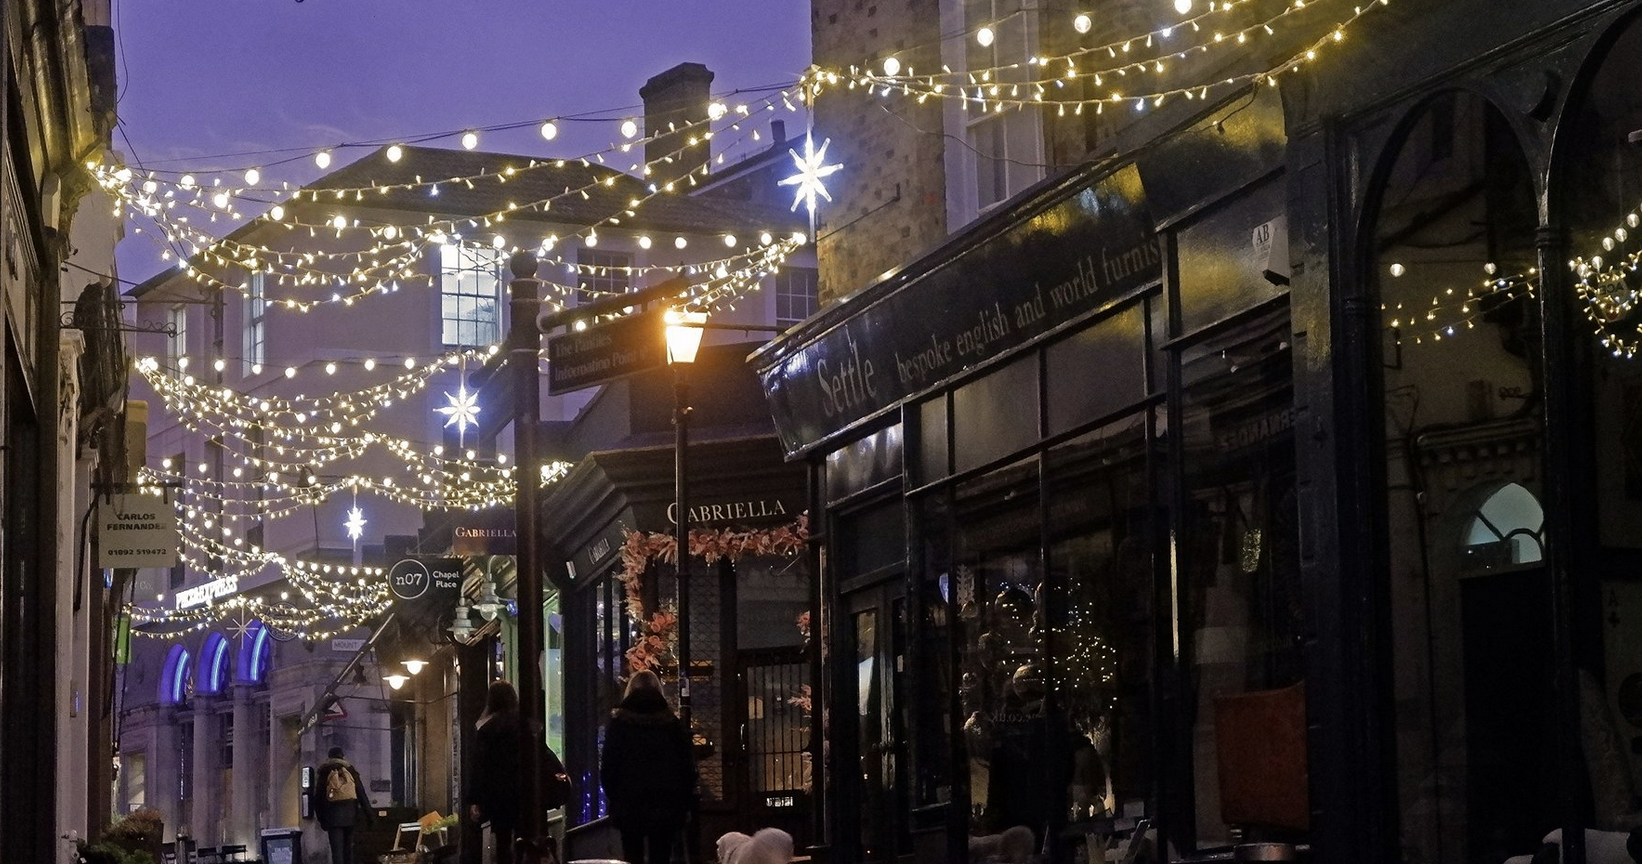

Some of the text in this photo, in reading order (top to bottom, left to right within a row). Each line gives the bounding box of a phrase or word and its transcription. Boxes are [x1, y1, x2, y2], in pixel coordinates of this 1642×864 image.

[817, 336, 877, 418] Settle
[895, 333, 953, 384] bespoke
[956, 302, 1010, 356] english
[1015, 282, 1046, 329] and
[1049, 255, 1098, 308] world
[116, 513, 156, 521] CARLOS
[108, 548, 167, 556] 01892 519472
[432, 570, 460, 580] Chapel
[435, 580, 458, 588] Place
